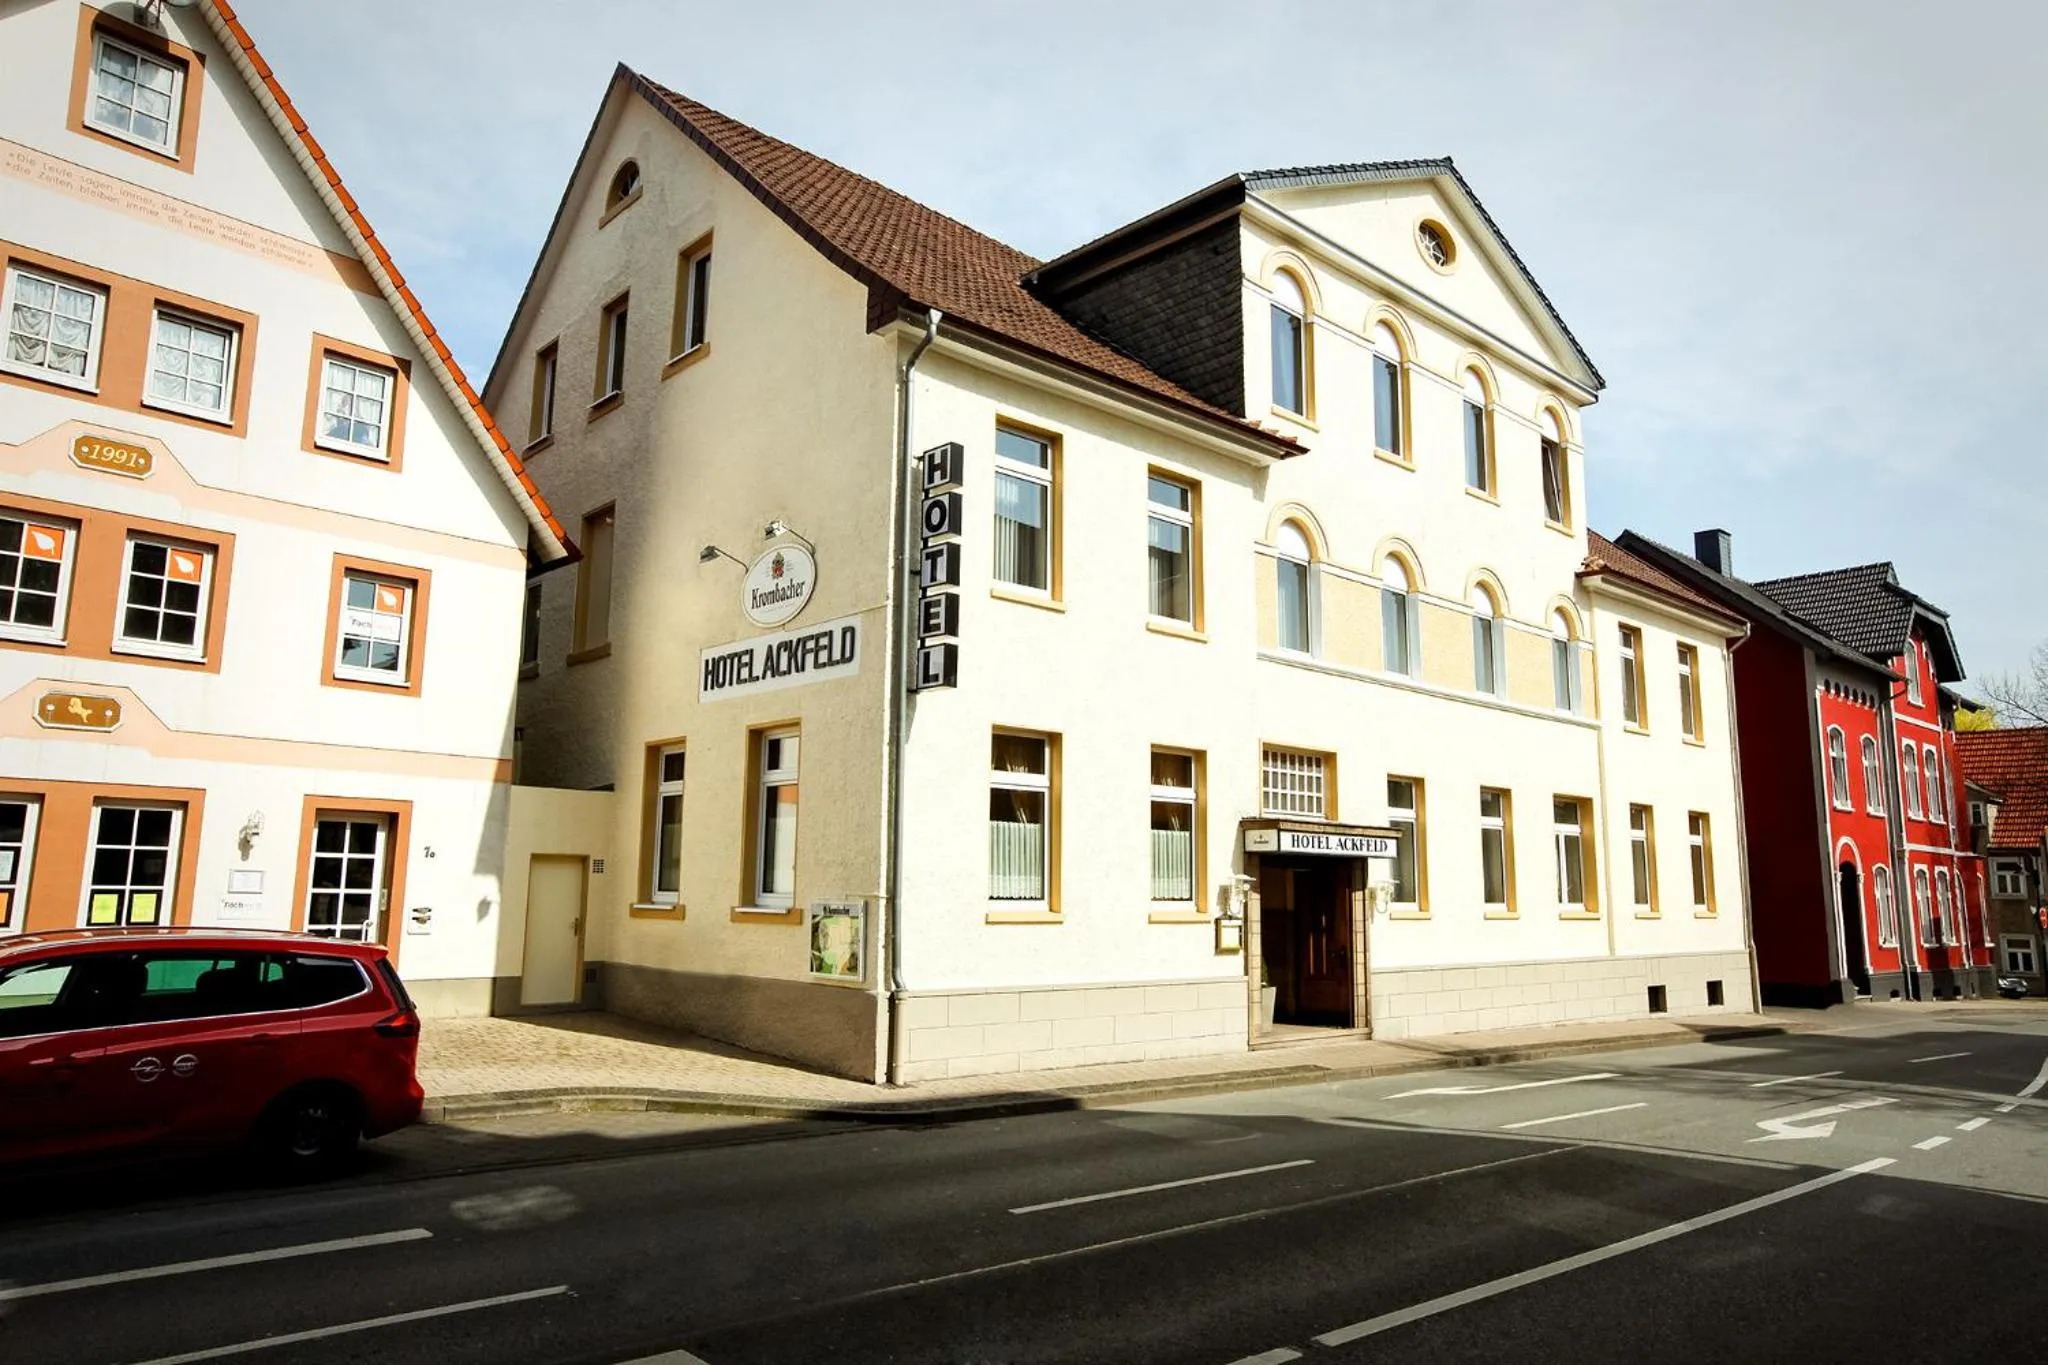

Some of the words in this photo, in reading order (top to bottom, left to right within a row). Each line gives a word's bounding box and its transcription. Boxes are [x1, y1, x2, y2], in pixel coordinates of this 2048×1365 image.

[88, 444, 138, 468] 1991
[921, 449, 948, 685] HOTEL
[751, 577, 806, 610] Krombacher
[703, 648, 760, 692] HOTEL
[761, 625, 857, 681] ACKFELD
[1291, 834, 1332, 850] HOTEL
[1335, 837, 1389, 853] ACKFELD
